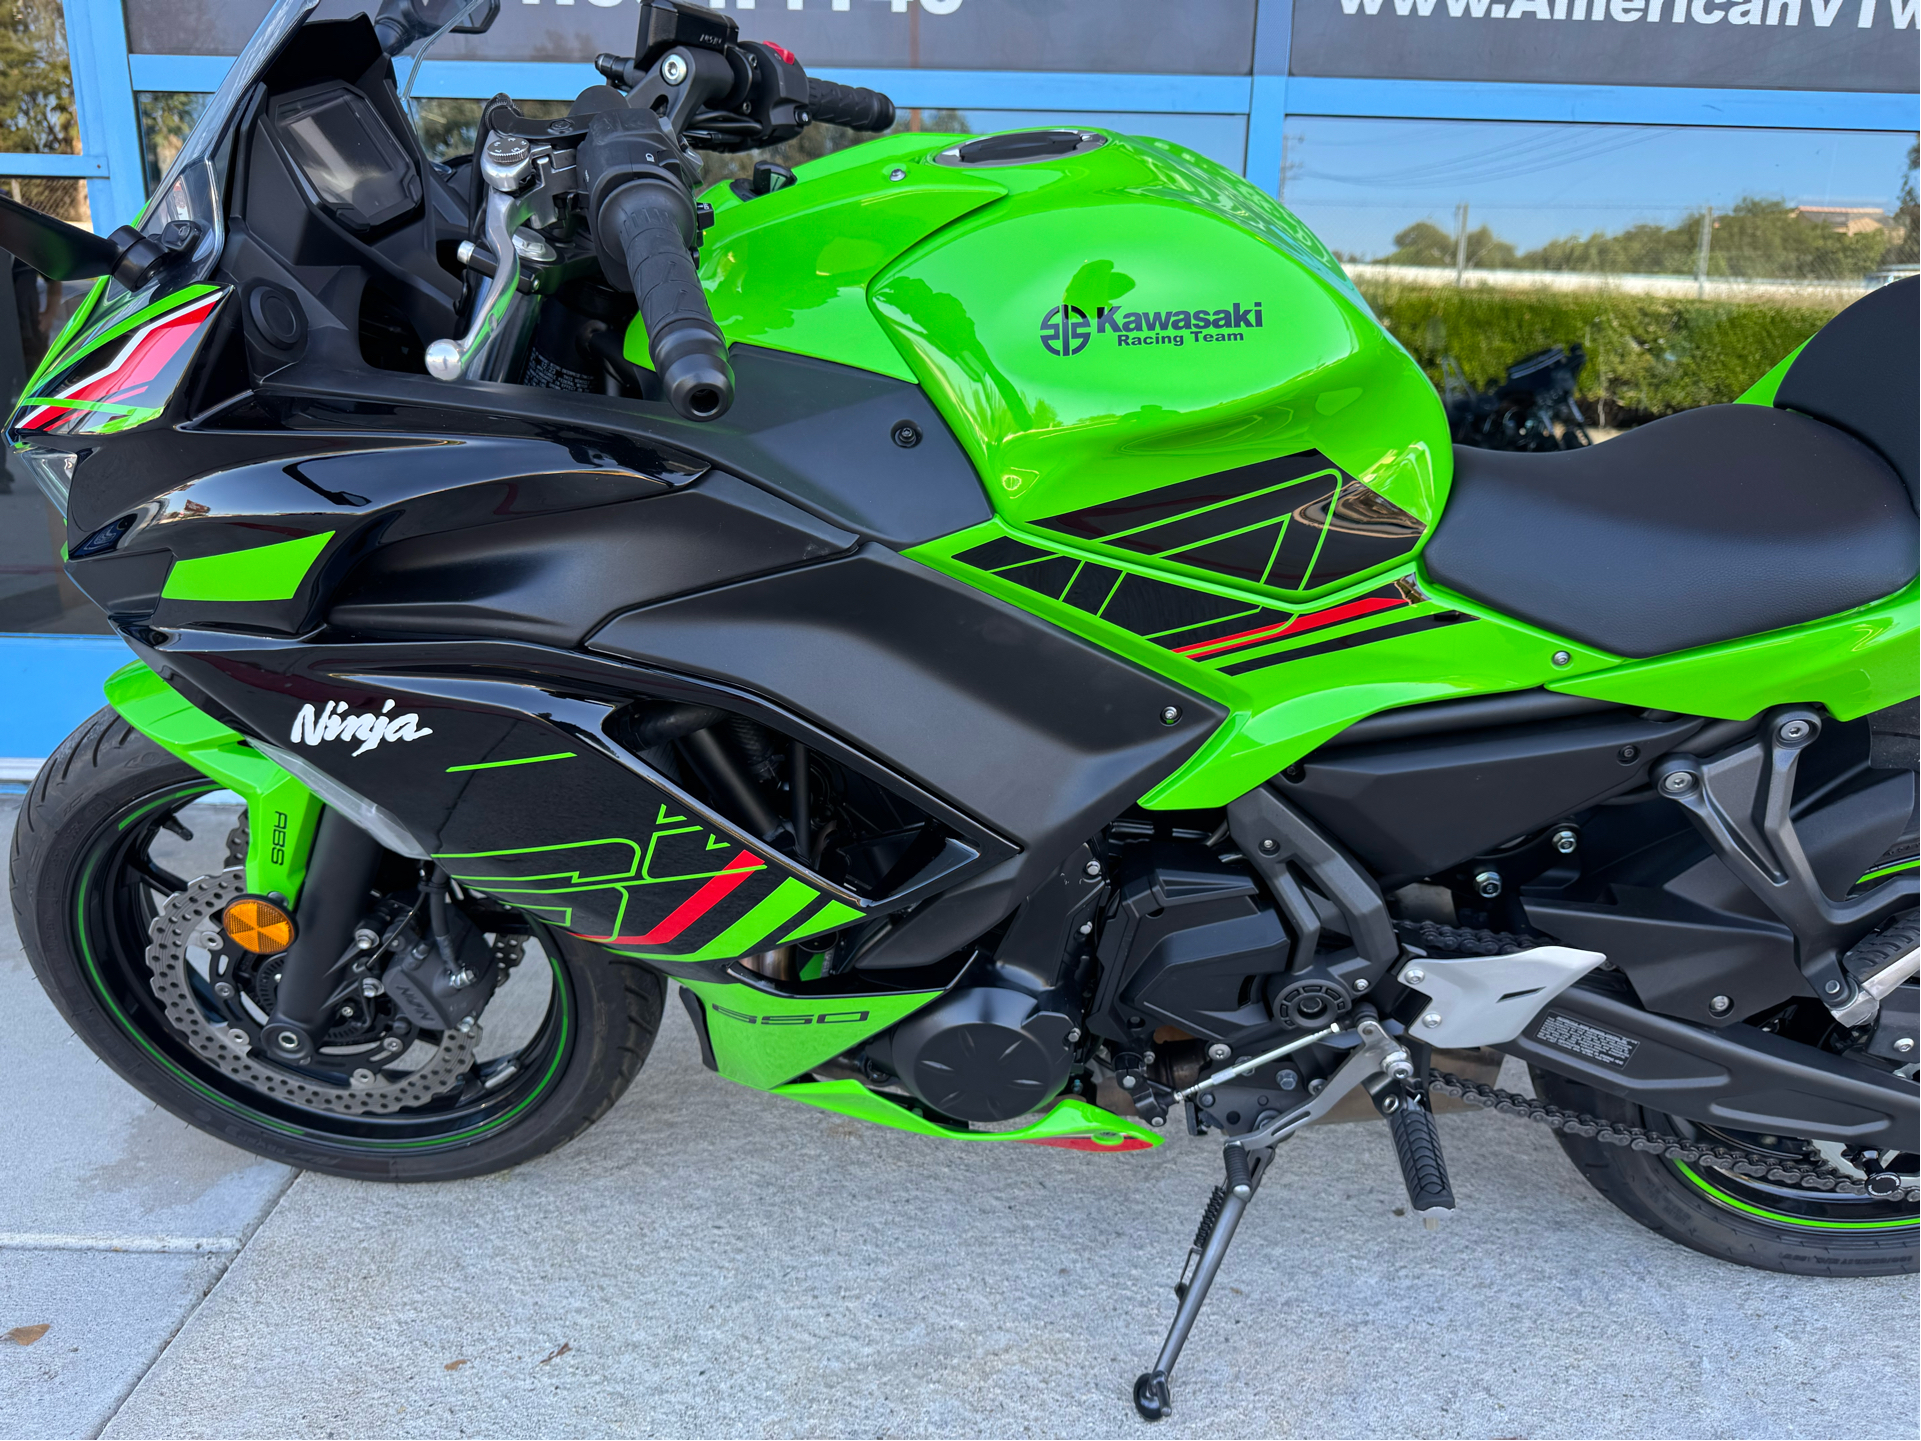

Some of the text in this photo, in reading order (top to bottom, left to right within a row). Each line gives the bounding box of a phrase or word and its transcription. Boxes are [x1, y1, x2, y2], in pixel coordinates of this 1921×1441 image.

[1096, 302, 1264, 334] Kawasaki
[1117, 330, 1244, 347] Racing Team
[290, 699, 434, 758] Ninja
[271, 811, 288, 866] ABS
[712, 1003, 870, 1025] 650
